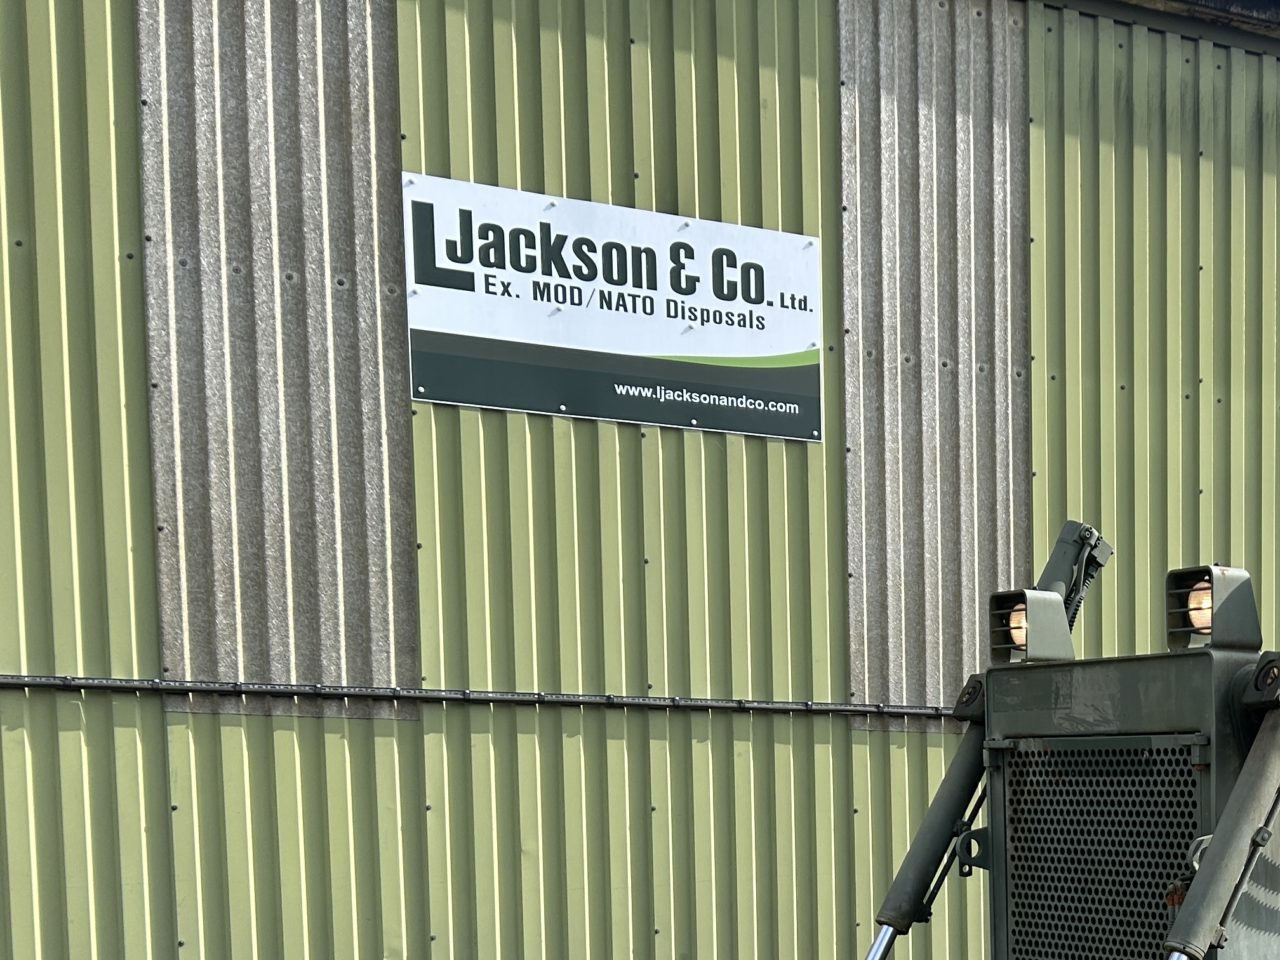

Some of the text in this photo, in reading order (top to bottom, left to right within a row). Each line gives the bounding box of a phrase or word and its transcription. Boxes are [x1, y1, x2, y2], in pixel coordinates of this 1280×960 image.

[484, 273, 766, 330] Ex. MOD/NATO Disposals
[669, 241, 700, 296] &
[711, 247, 774, 307] Co.
[780, 292, 814, 313] Ltd.
[614, 383, 800, 414] www.ljacksonandco.com
